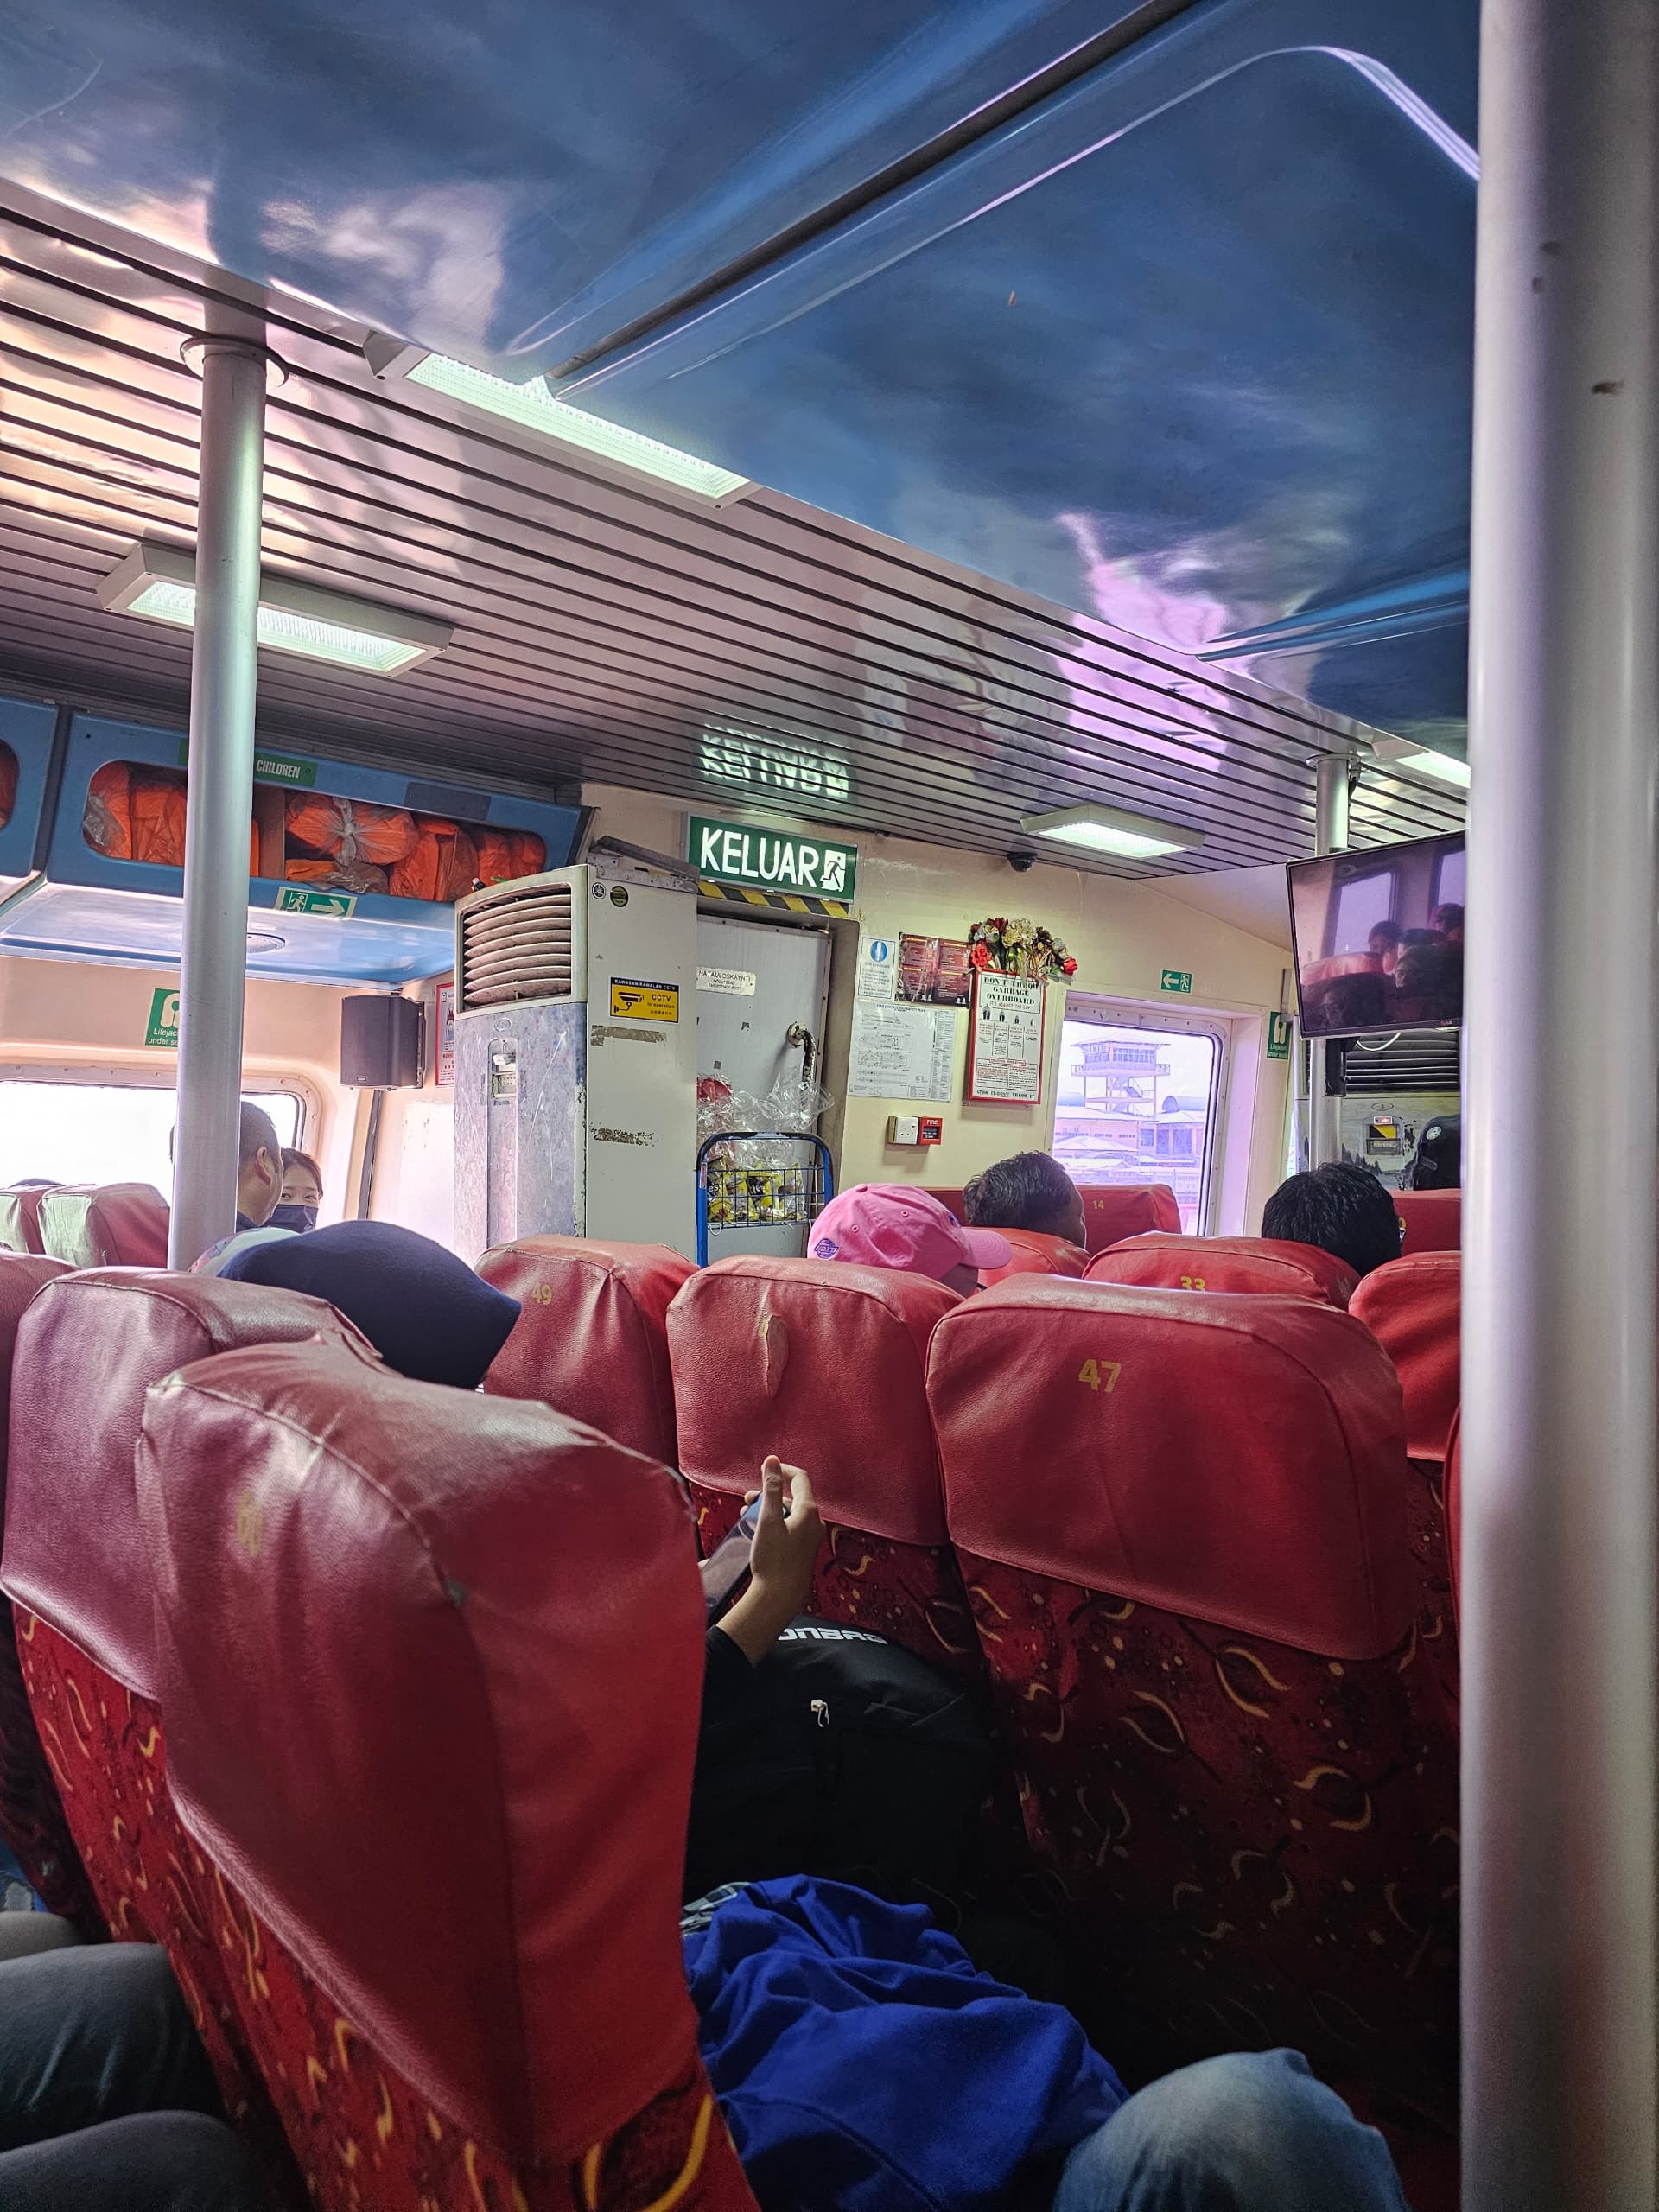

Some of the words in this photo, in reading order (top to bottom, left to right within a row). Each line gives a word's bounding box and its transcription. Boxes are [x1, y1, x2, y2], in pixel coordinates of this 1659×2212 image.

[257, 760, 301, 779] CHILDREN
[700, 827, 819, 888] KELUAR
[984, 976, 1007, 986] DON'T
[993, 986, 1029, 996] GARBAGE
[652, 994, 671, 1002] CCTV
[987, 993, 1035, 1005] OVERBOARD
[153, 1027, 178, 1038] Lifejac
[148, 1037, 169, 1046] under
[1093, 1200, 1104, 1210] 14
[1180, 1275, 1206, 1291] 33
[532, 1284, 552, 1306] 49
[1077, 1358, 1122, 1393] 47
